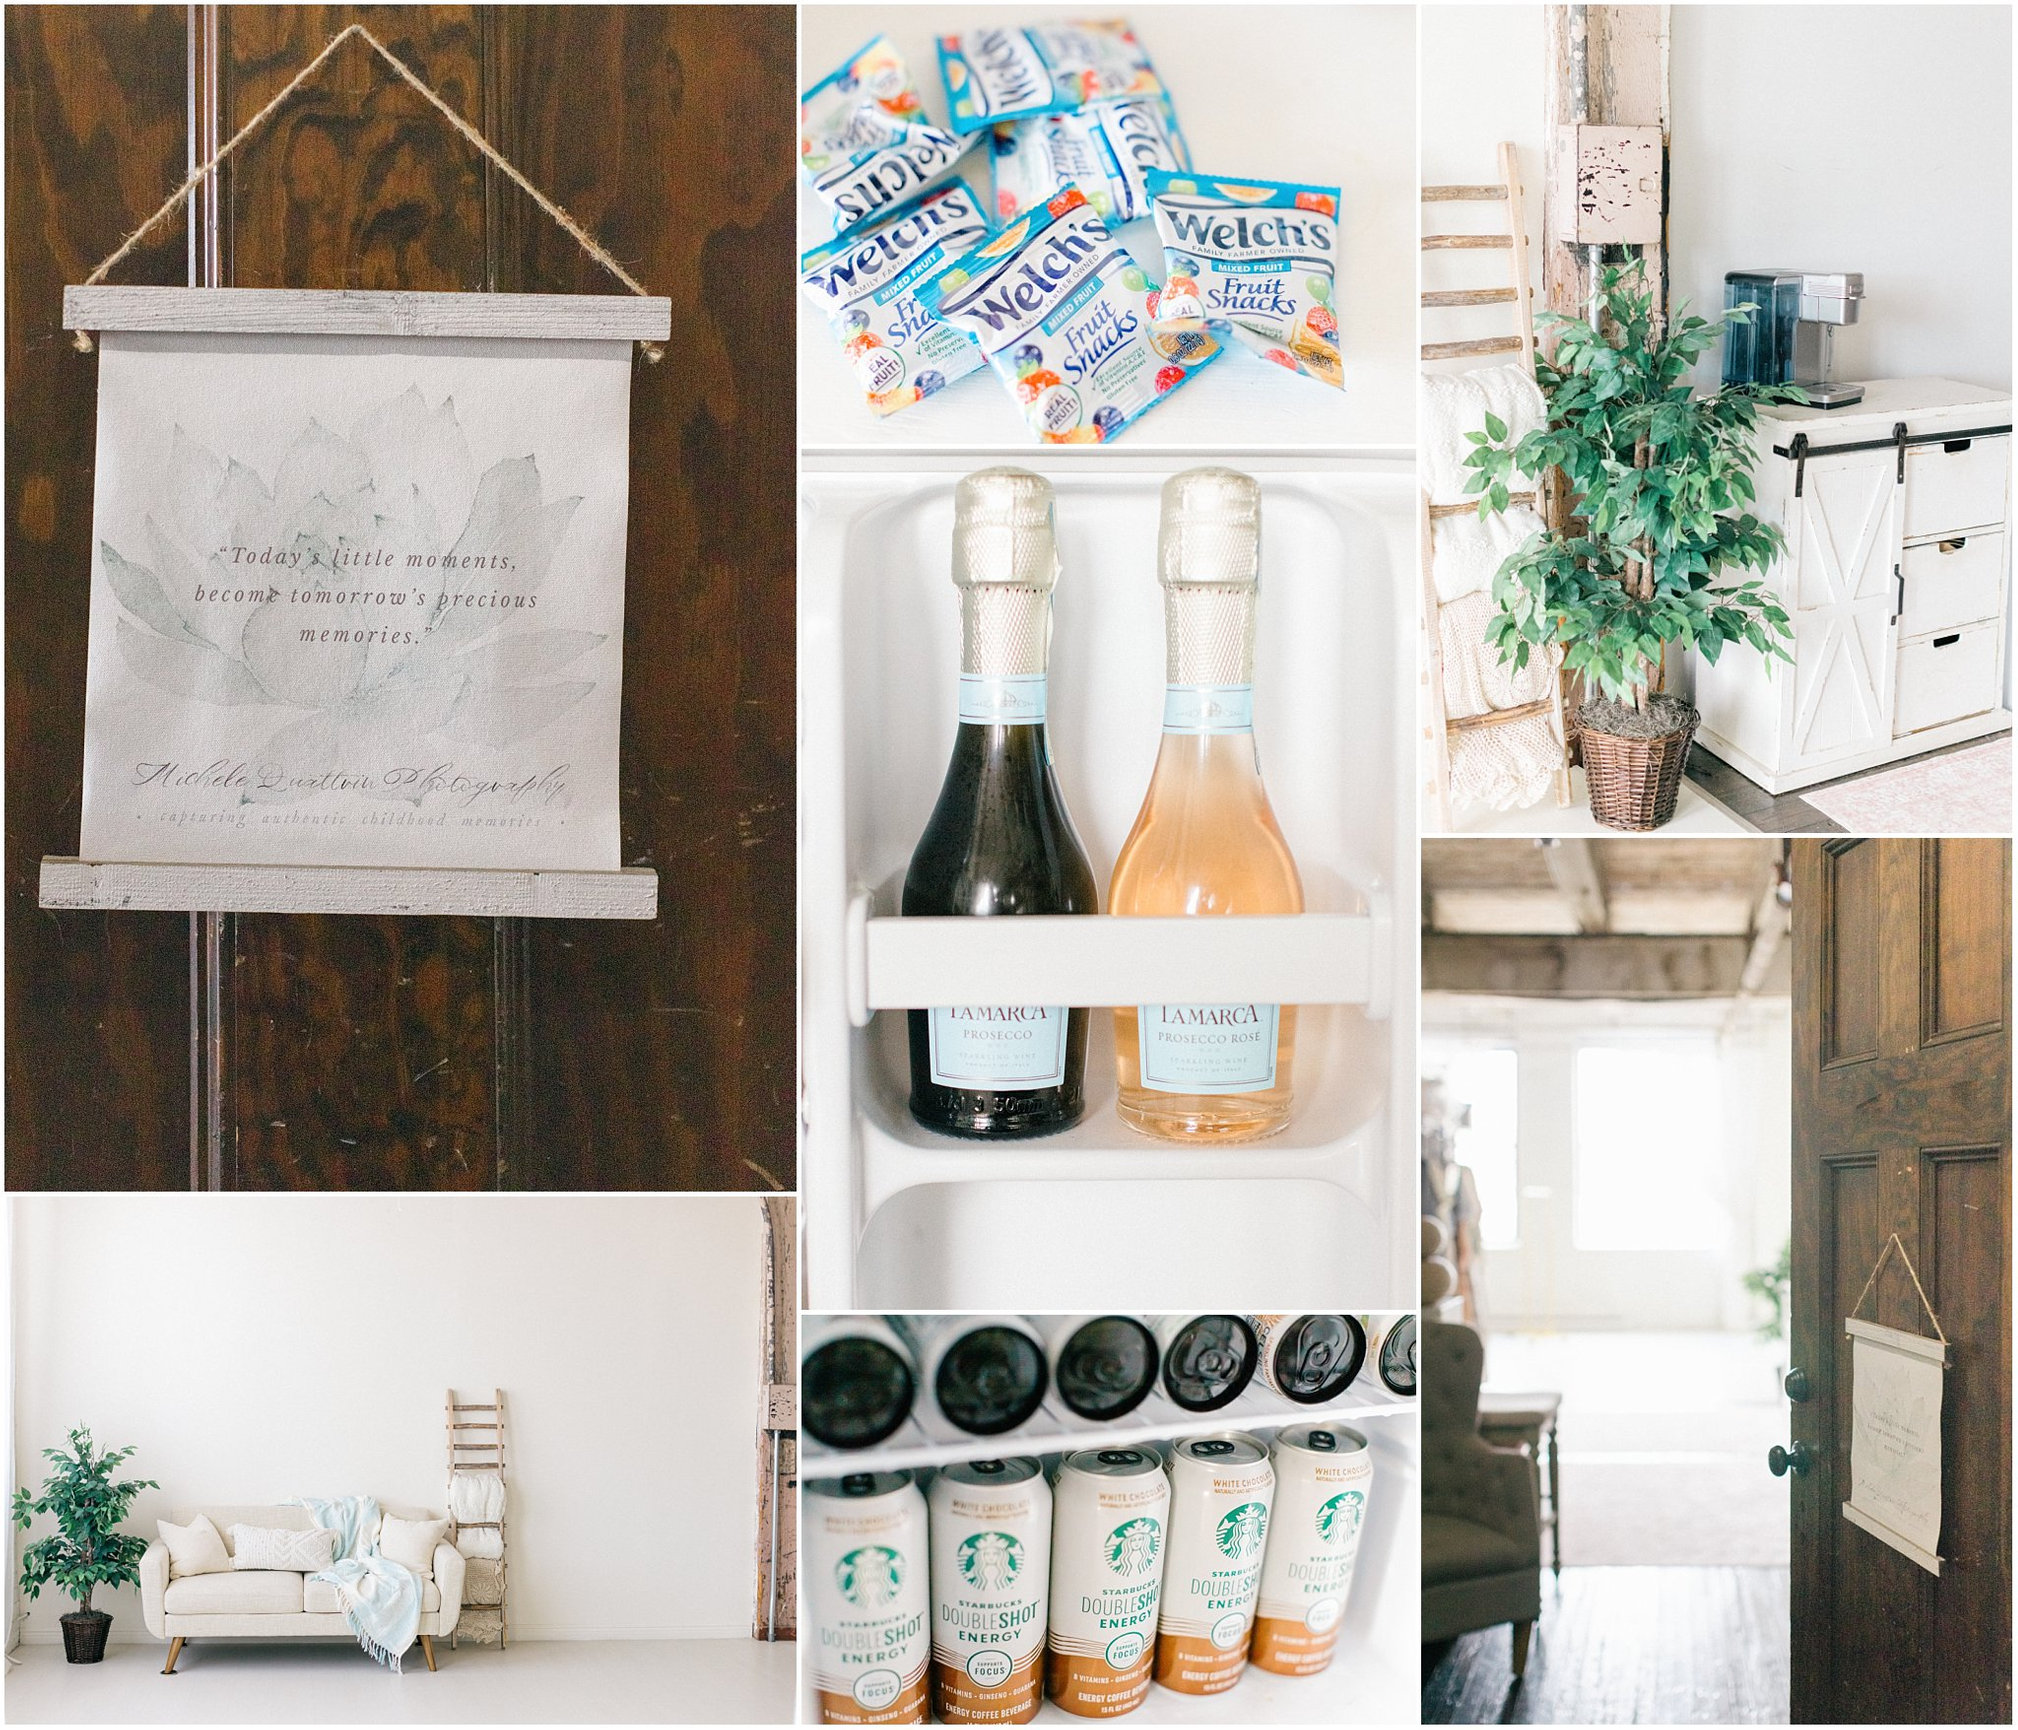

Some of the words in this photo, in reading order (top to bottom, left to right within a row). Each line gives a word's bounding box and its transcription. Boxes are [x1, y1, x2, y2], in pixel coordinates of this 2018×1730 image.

[1163, 209, 1331, 250] Welch's
[1191, 245, 1224, 257] FAMILY
[1227, 248, 1266, 259] FARMER
[963, 218, 1114, 332] Welch's
[1073, 253, 1100, 279] OWNED
[1218, 263, 1250, 273] MIXED
[1253, 262, 1284, 272] FRUIT
[880, 275, 911, 301] MIXED
[910, 253, 939, 280] FRUIT
[1223, 277, 1286, 296] Fruit
[1048, 303, 1074, 333] MIXED
[1073, 281, 1098, 307] FRUIT
[1206, 289, 1297, 316] Snacks
[1064, 299, 1116, 354] Fruit
[1064, 310, 1139, 386] Snacks
[1044, 394, 1067, 419] REAL
[1048, 398, 1079, 431] FRUIT!
[333, 548, 394, 567] little
[406, 554, 516, 572] moments,
[195, 584, 278, 603] become
[291, 588, 426, 606] tomorrow’s
[437, 590, 537, 610] precious
[131, 759, 248, 787] Michele
[381, 763, 571, 808] Photography
[160, 810, 246, 829] capturing
[262, 810, 346, 825] authentic
[361, 812, 446, 827] childhood
[462, 815, 540, 828] memories
[963, 1029, 1033, 1040] PROSECCO
[1158, 1031, 1227, 1044] PROSECCO
[1315, 1467, 1341, 1476] WHITE
[1099, 1492, 1127, 1501] WHITE
[1129, 1483, 1165, 1501] CHOCOLATE
[1213, 1479, 1240, 1487] WHITE
[1102, 1579, 1156, 1595] STARBUCKS
[959, 1599, 1022, 1609] STARBUCKS
[943, 1601, 1038, 1630] DOUBLESHOT
[1100, 1608, 1153, 1629] ENERGY
[821, 1614, 921, 1649] DOUBLESHOT
[959, 1629, 1022, 1643] ENERGY
[842, 1644, 908, 1663] ENERGY
[1113, 1647, 1139, 1660] FOCUS
[975, 1667, 1005, 1675] FOCUS
[1079, 1675, 1109, 1684] VITAMINS
[863, 1686, 894, 1697] FOCUS
[945, 1685, 972, 1699] VITAMINS
[979, 1691, 1007, 1700] GINSENG
[1078, 1692, 1105, 1703] ENERGY
[945, 1702, 970, 1718] ENERGY
[971, 1710, 1000, 1719] COFFEE
[1001, 1699, 1032, 1718] BEVERAGE
